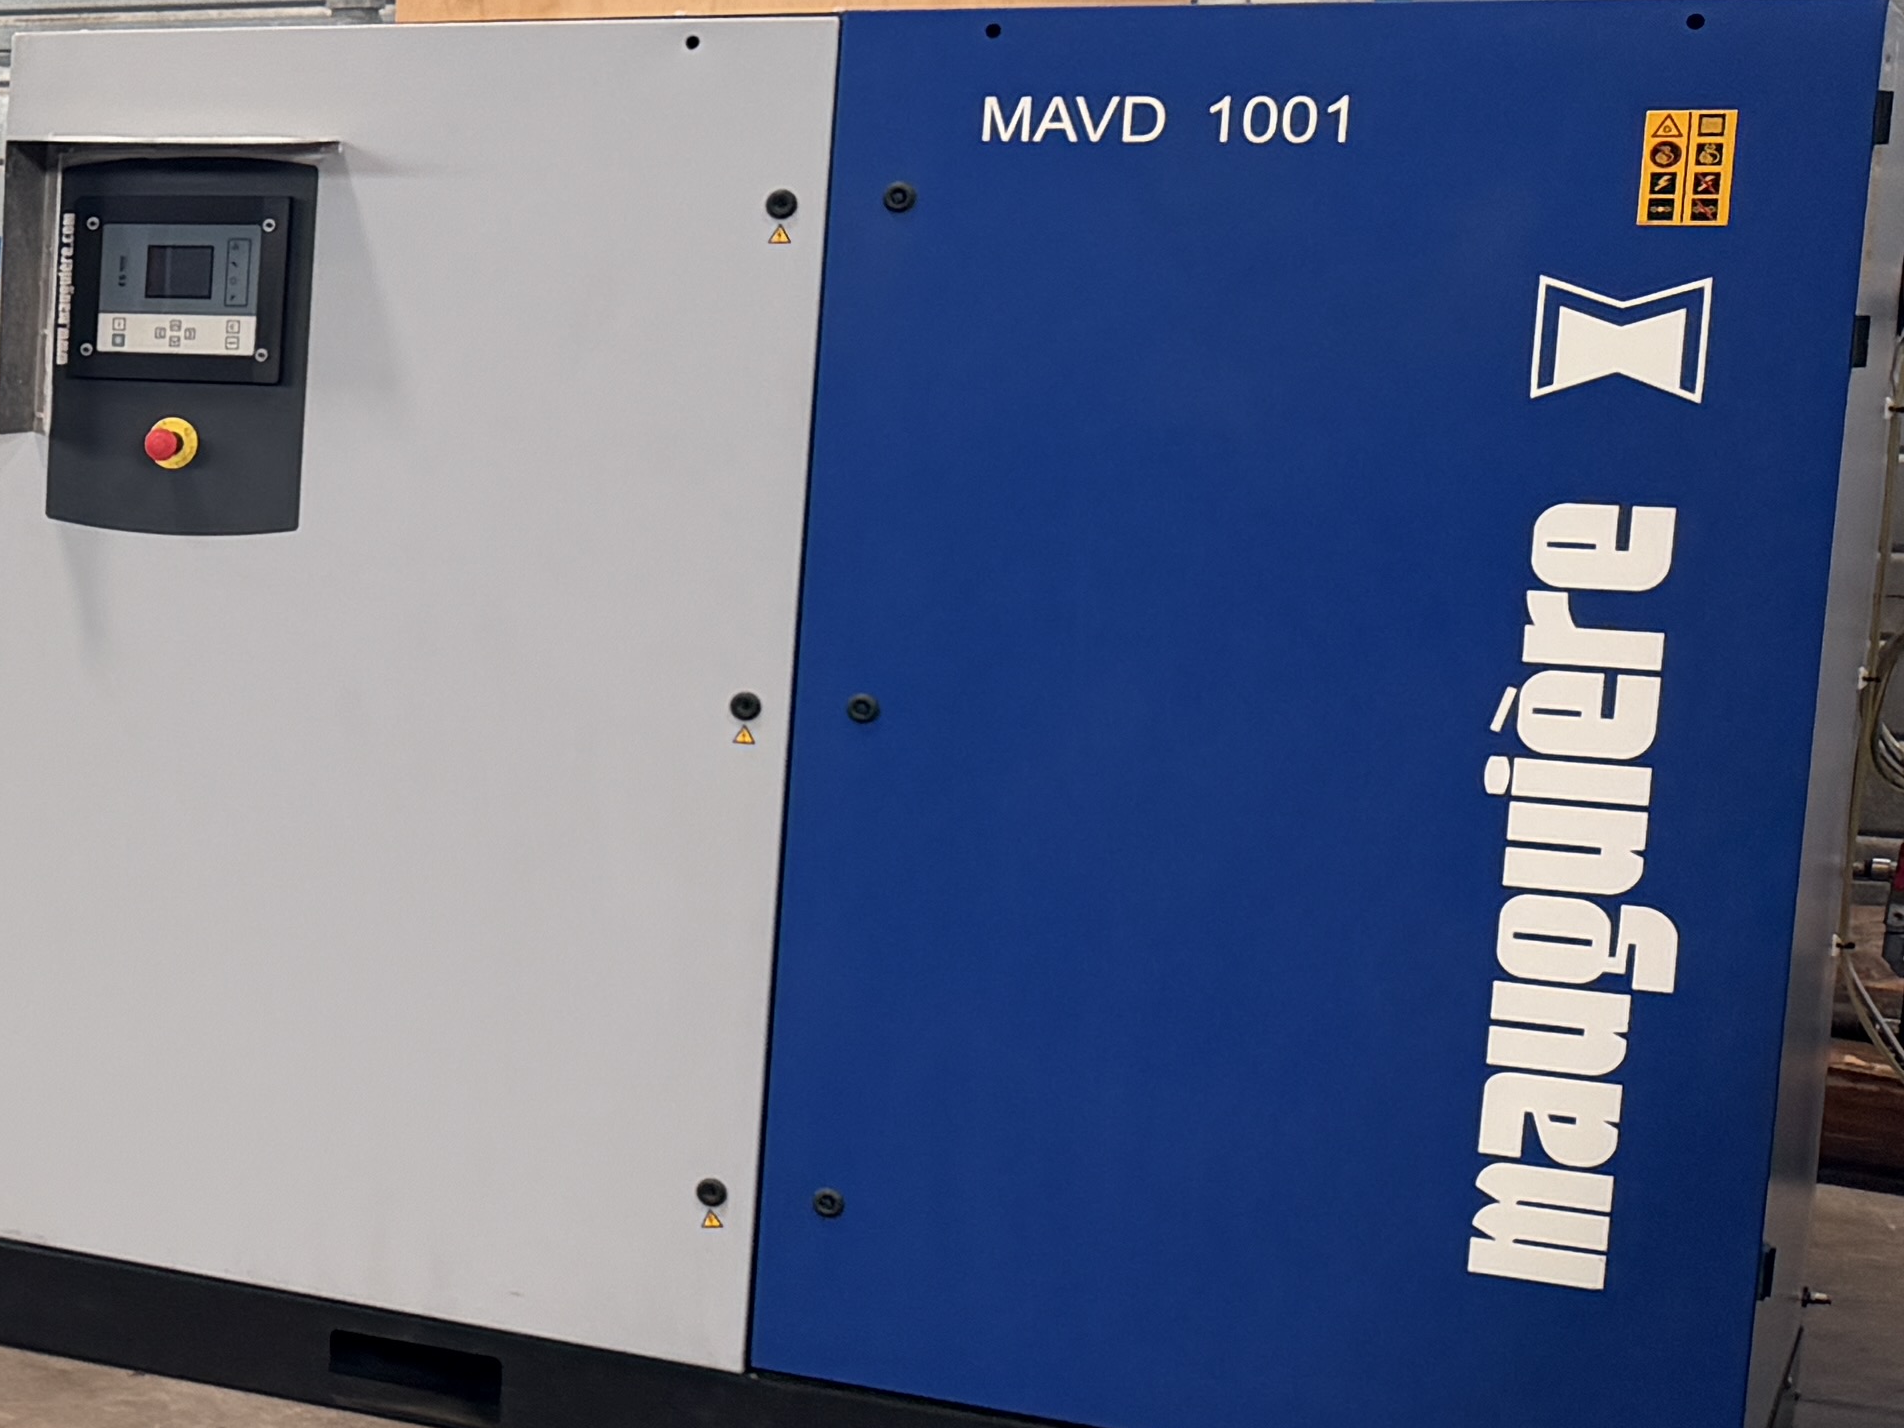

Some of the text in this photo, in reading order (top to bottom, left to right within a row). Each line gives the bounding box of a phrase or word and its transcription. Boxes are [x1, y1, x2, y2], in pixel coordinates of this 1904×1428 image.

[981, 94, 1351, 144] MAVD 1001
[1467, 501, 1679, 1291] mauguière
